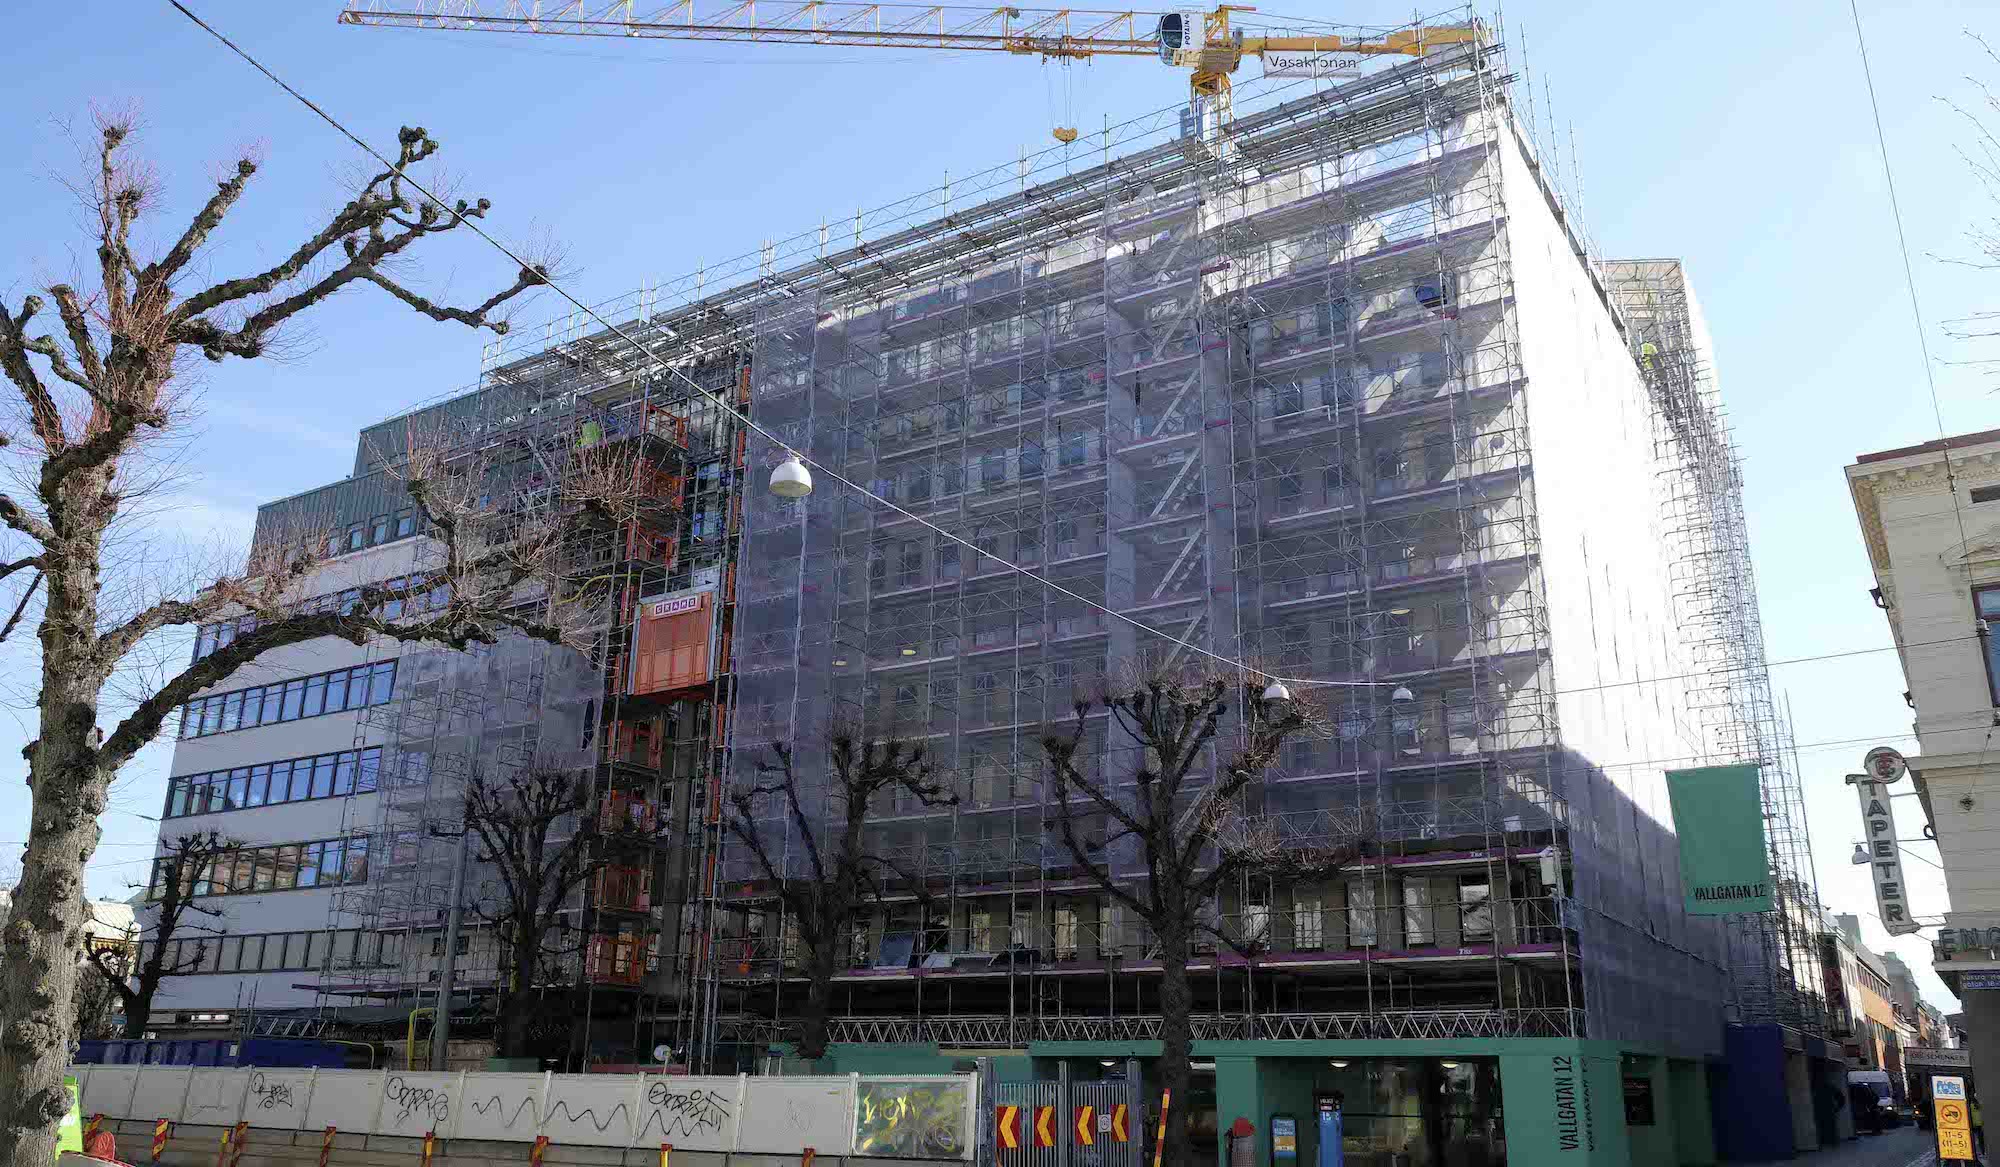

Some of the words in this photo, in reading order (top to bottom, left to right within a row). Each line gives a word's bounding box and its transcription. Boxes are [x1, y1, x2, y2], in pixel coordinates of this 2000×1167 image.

[655, 598, 696, 614] CRAMO
[1862, 780, 1904, 922] TAPETER
[1694, 885, 1751, 901] VALLGATAN
[1753, 883, 1766, 898] 12
[1553, 1056, 1573, 1073] 12
[1554, 1077, 1579, 1152] VALLGATAN
